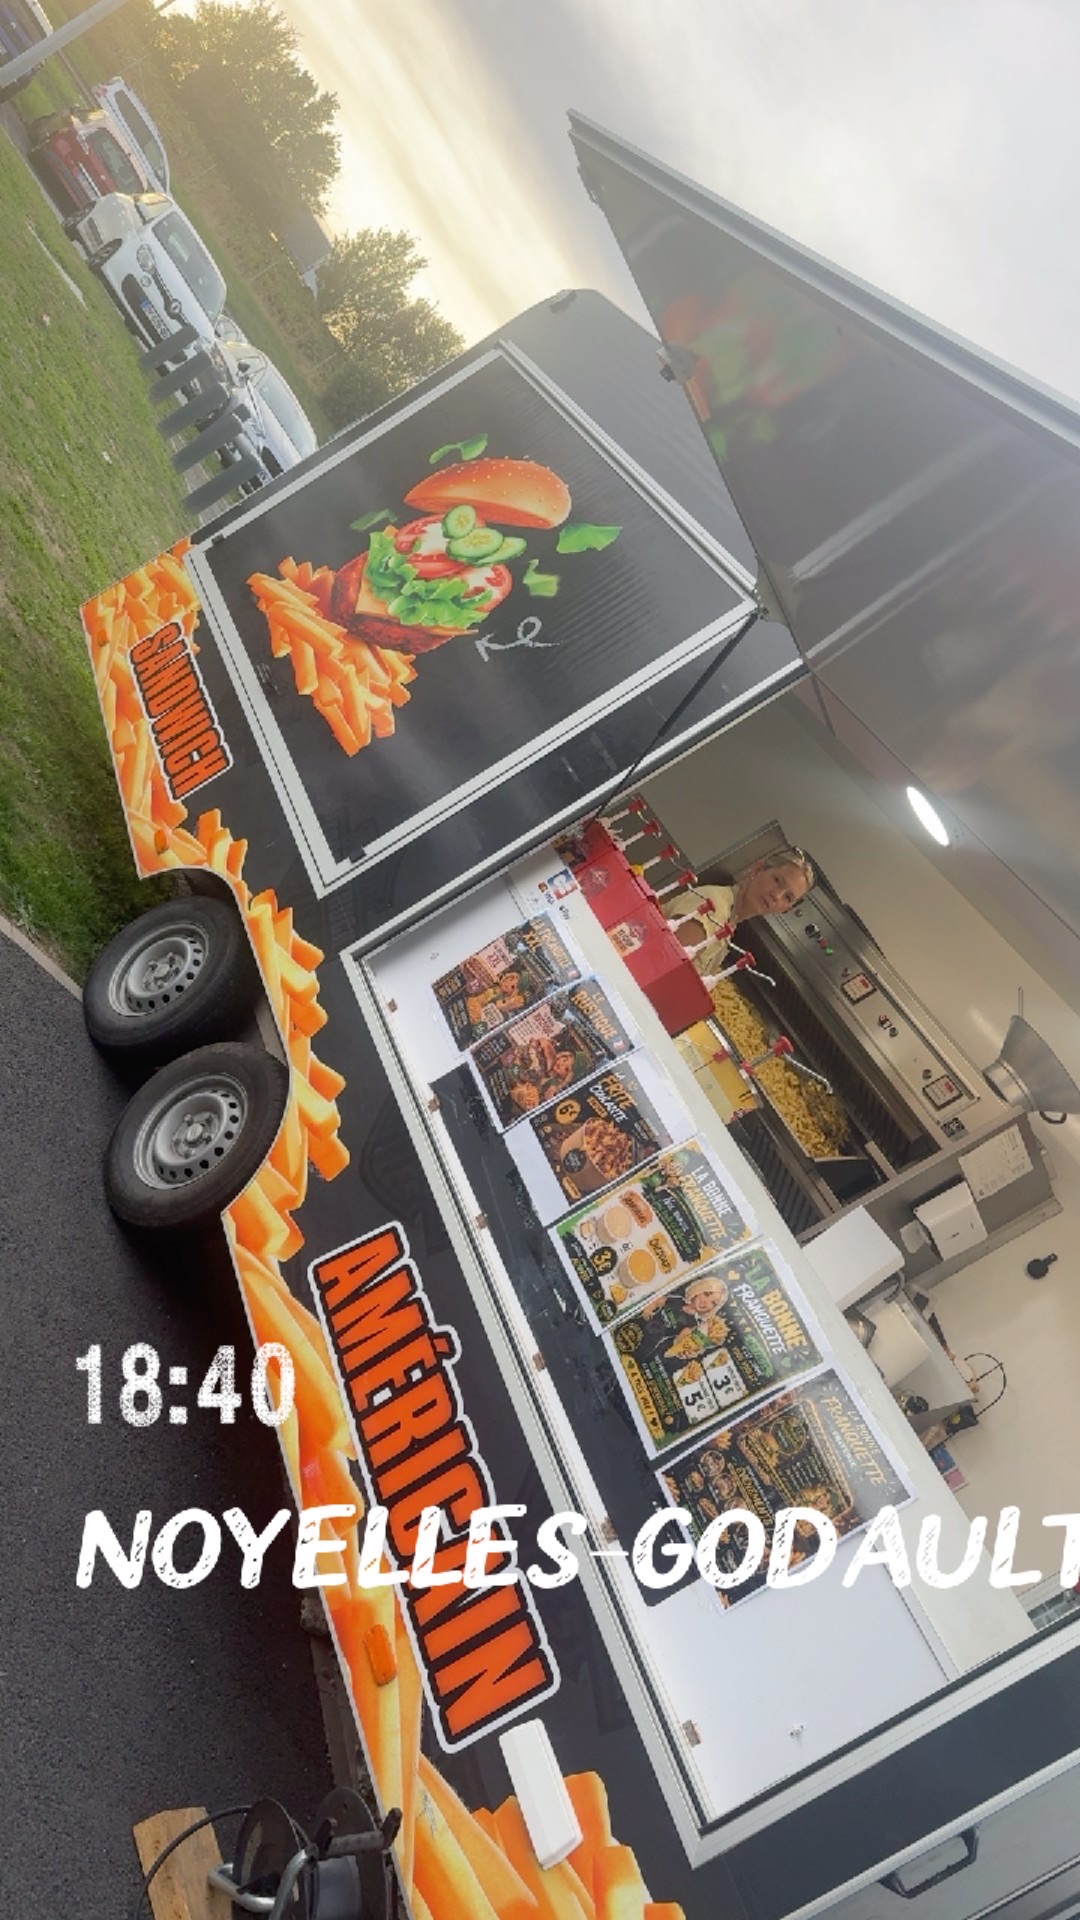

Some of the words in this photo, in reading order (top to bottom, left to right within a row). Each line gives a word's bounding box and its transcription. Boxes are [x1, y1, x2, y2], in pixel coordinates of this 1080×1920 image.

[130, 622, 230, 799] SANDWICH
[677, 1172, 727, 1241] FRANQUETTE
[690, 1164, 709, 1183] LA
[701, 1180, 733, 1218] BONNE
[733, 1283, 786, 1356] FRANQUETTE
[744, 1264, 771, 1292] LA
[760, 1288, 807, 1350] BONNE
[820, 1394, 888, 1487] FRANQUETTE
[846, 1408, 861, 1424] LA
[855, 1422, 880, 1455] BONNE
